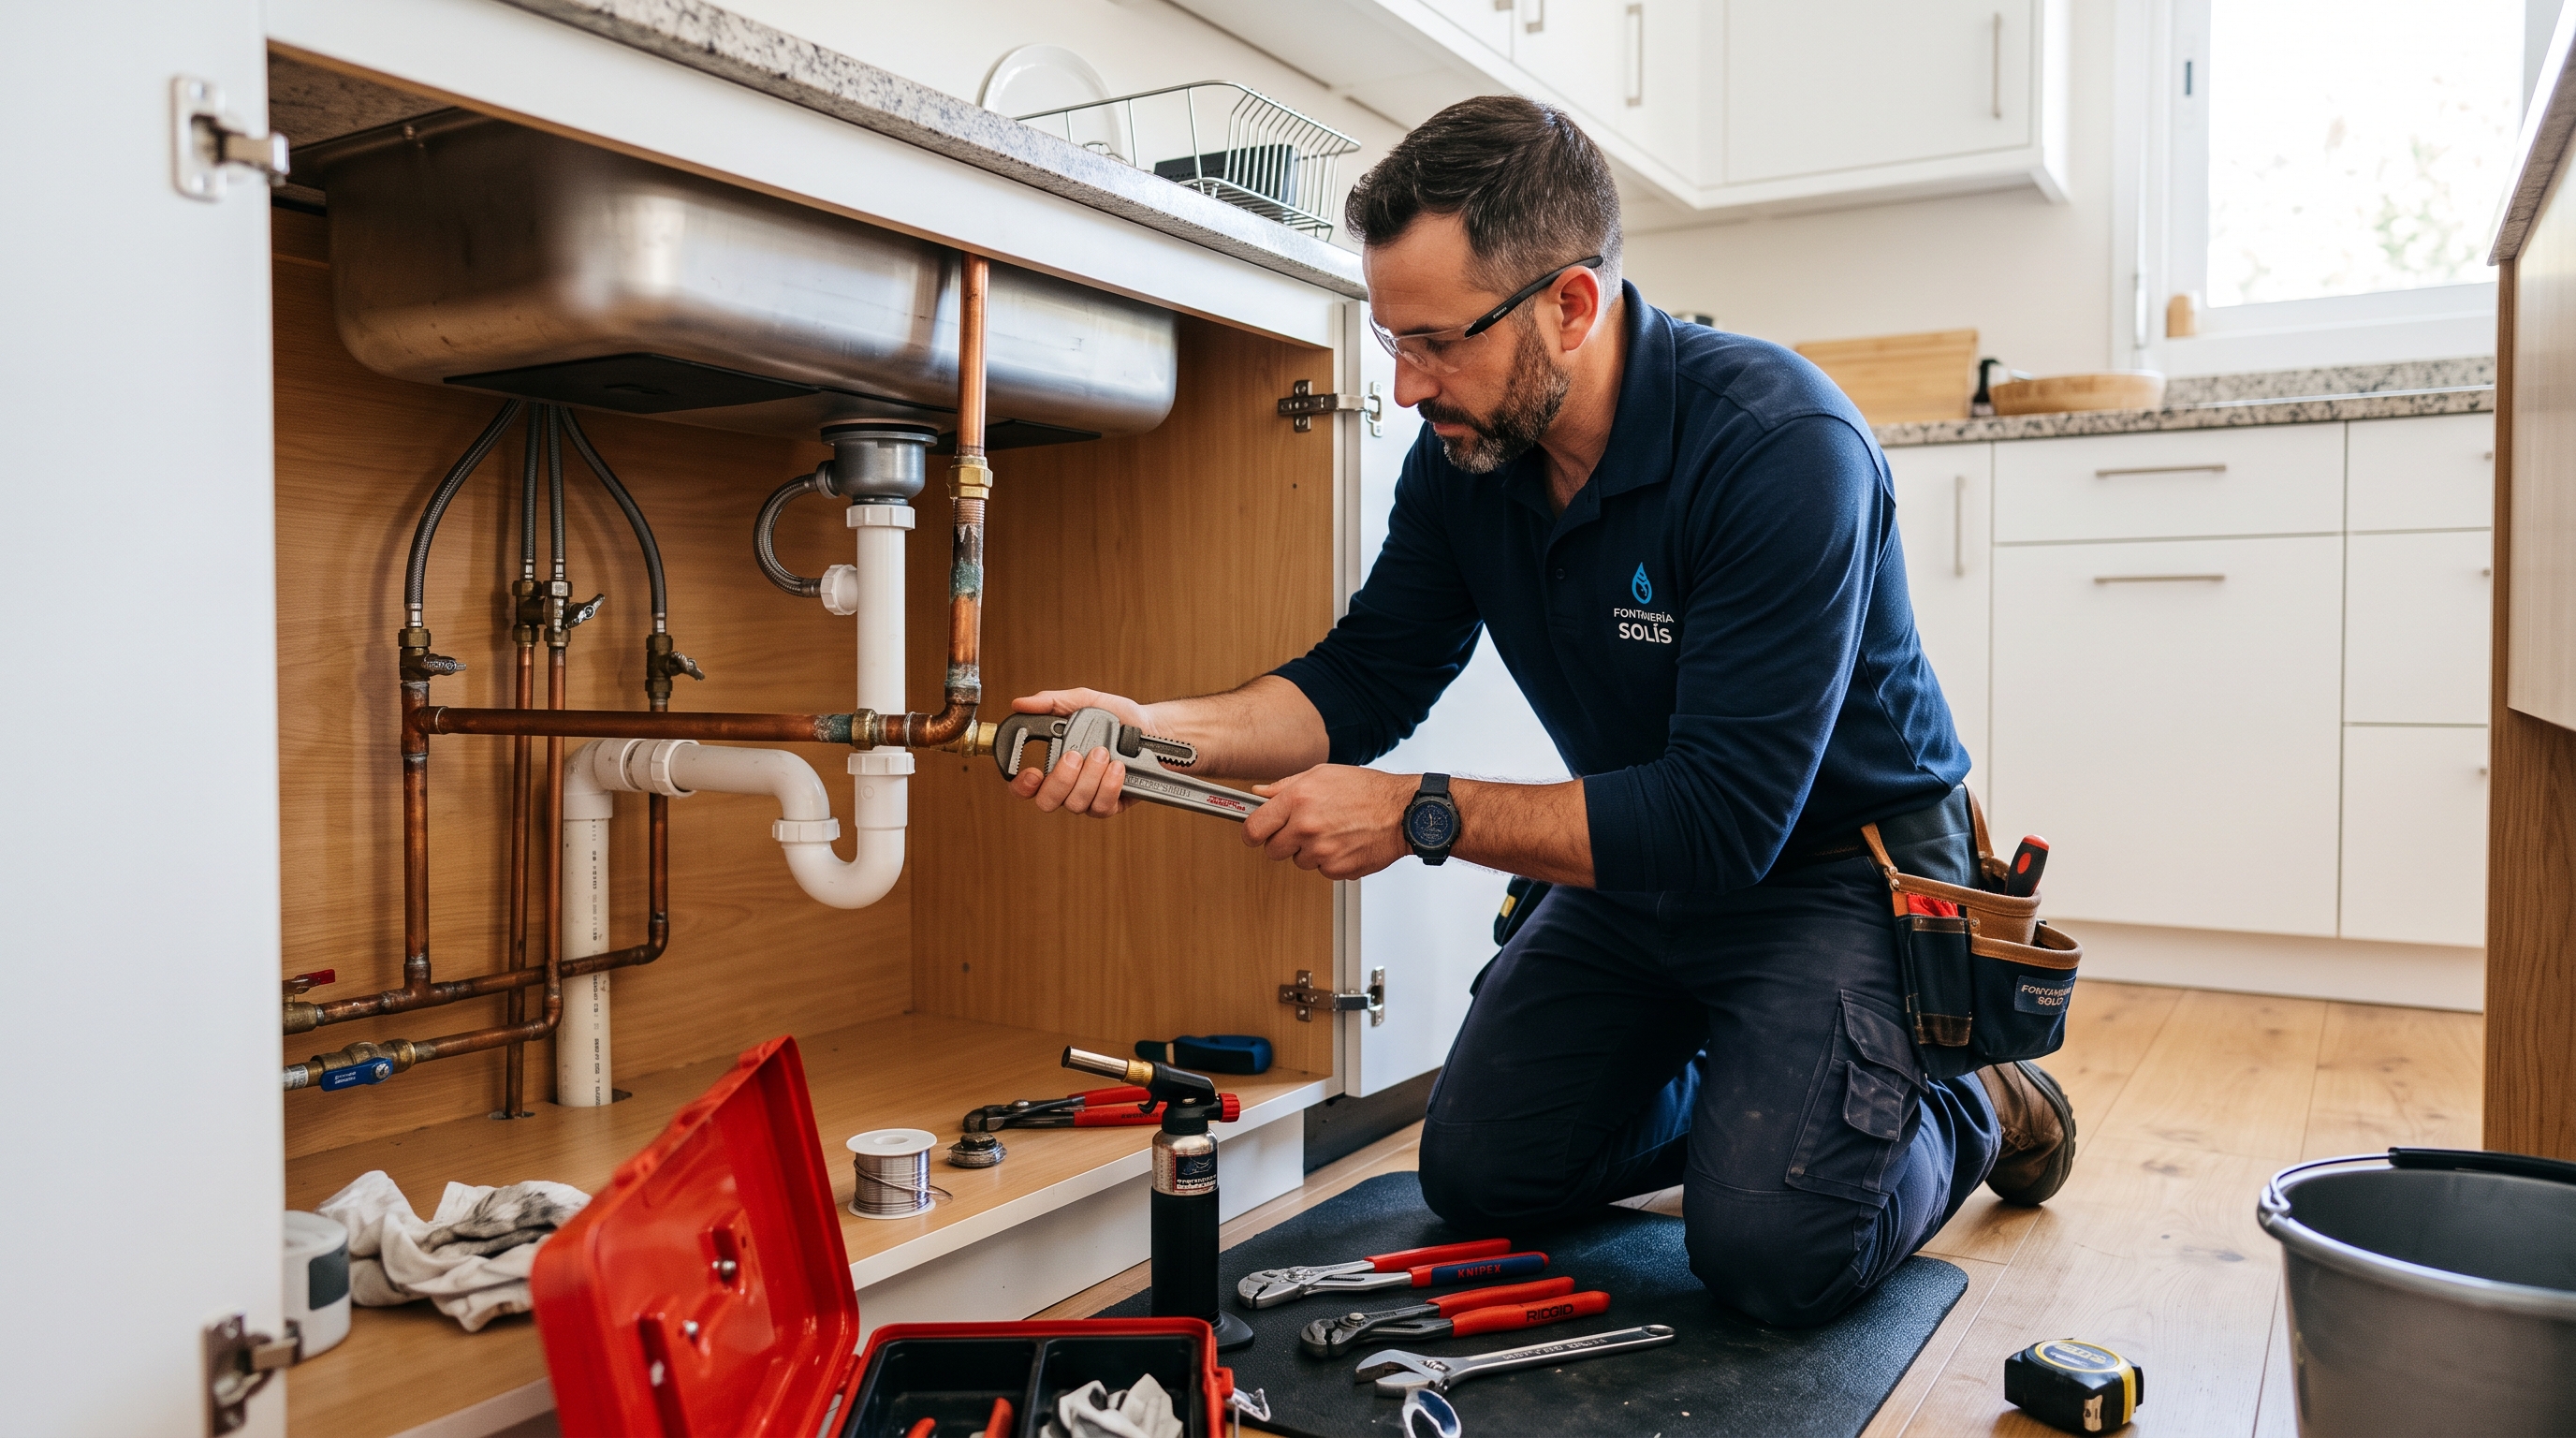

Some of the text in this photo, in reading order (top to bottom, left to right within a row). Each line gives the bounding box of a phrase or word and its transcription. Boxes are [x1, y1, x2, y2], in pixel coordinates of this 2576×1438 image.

[1618, 622, 1673, 644] SOLÍS
[1457, 1264, 1501, 1279] KNIPEX
[1526, 1303, 1574, 1323] RIDGID
